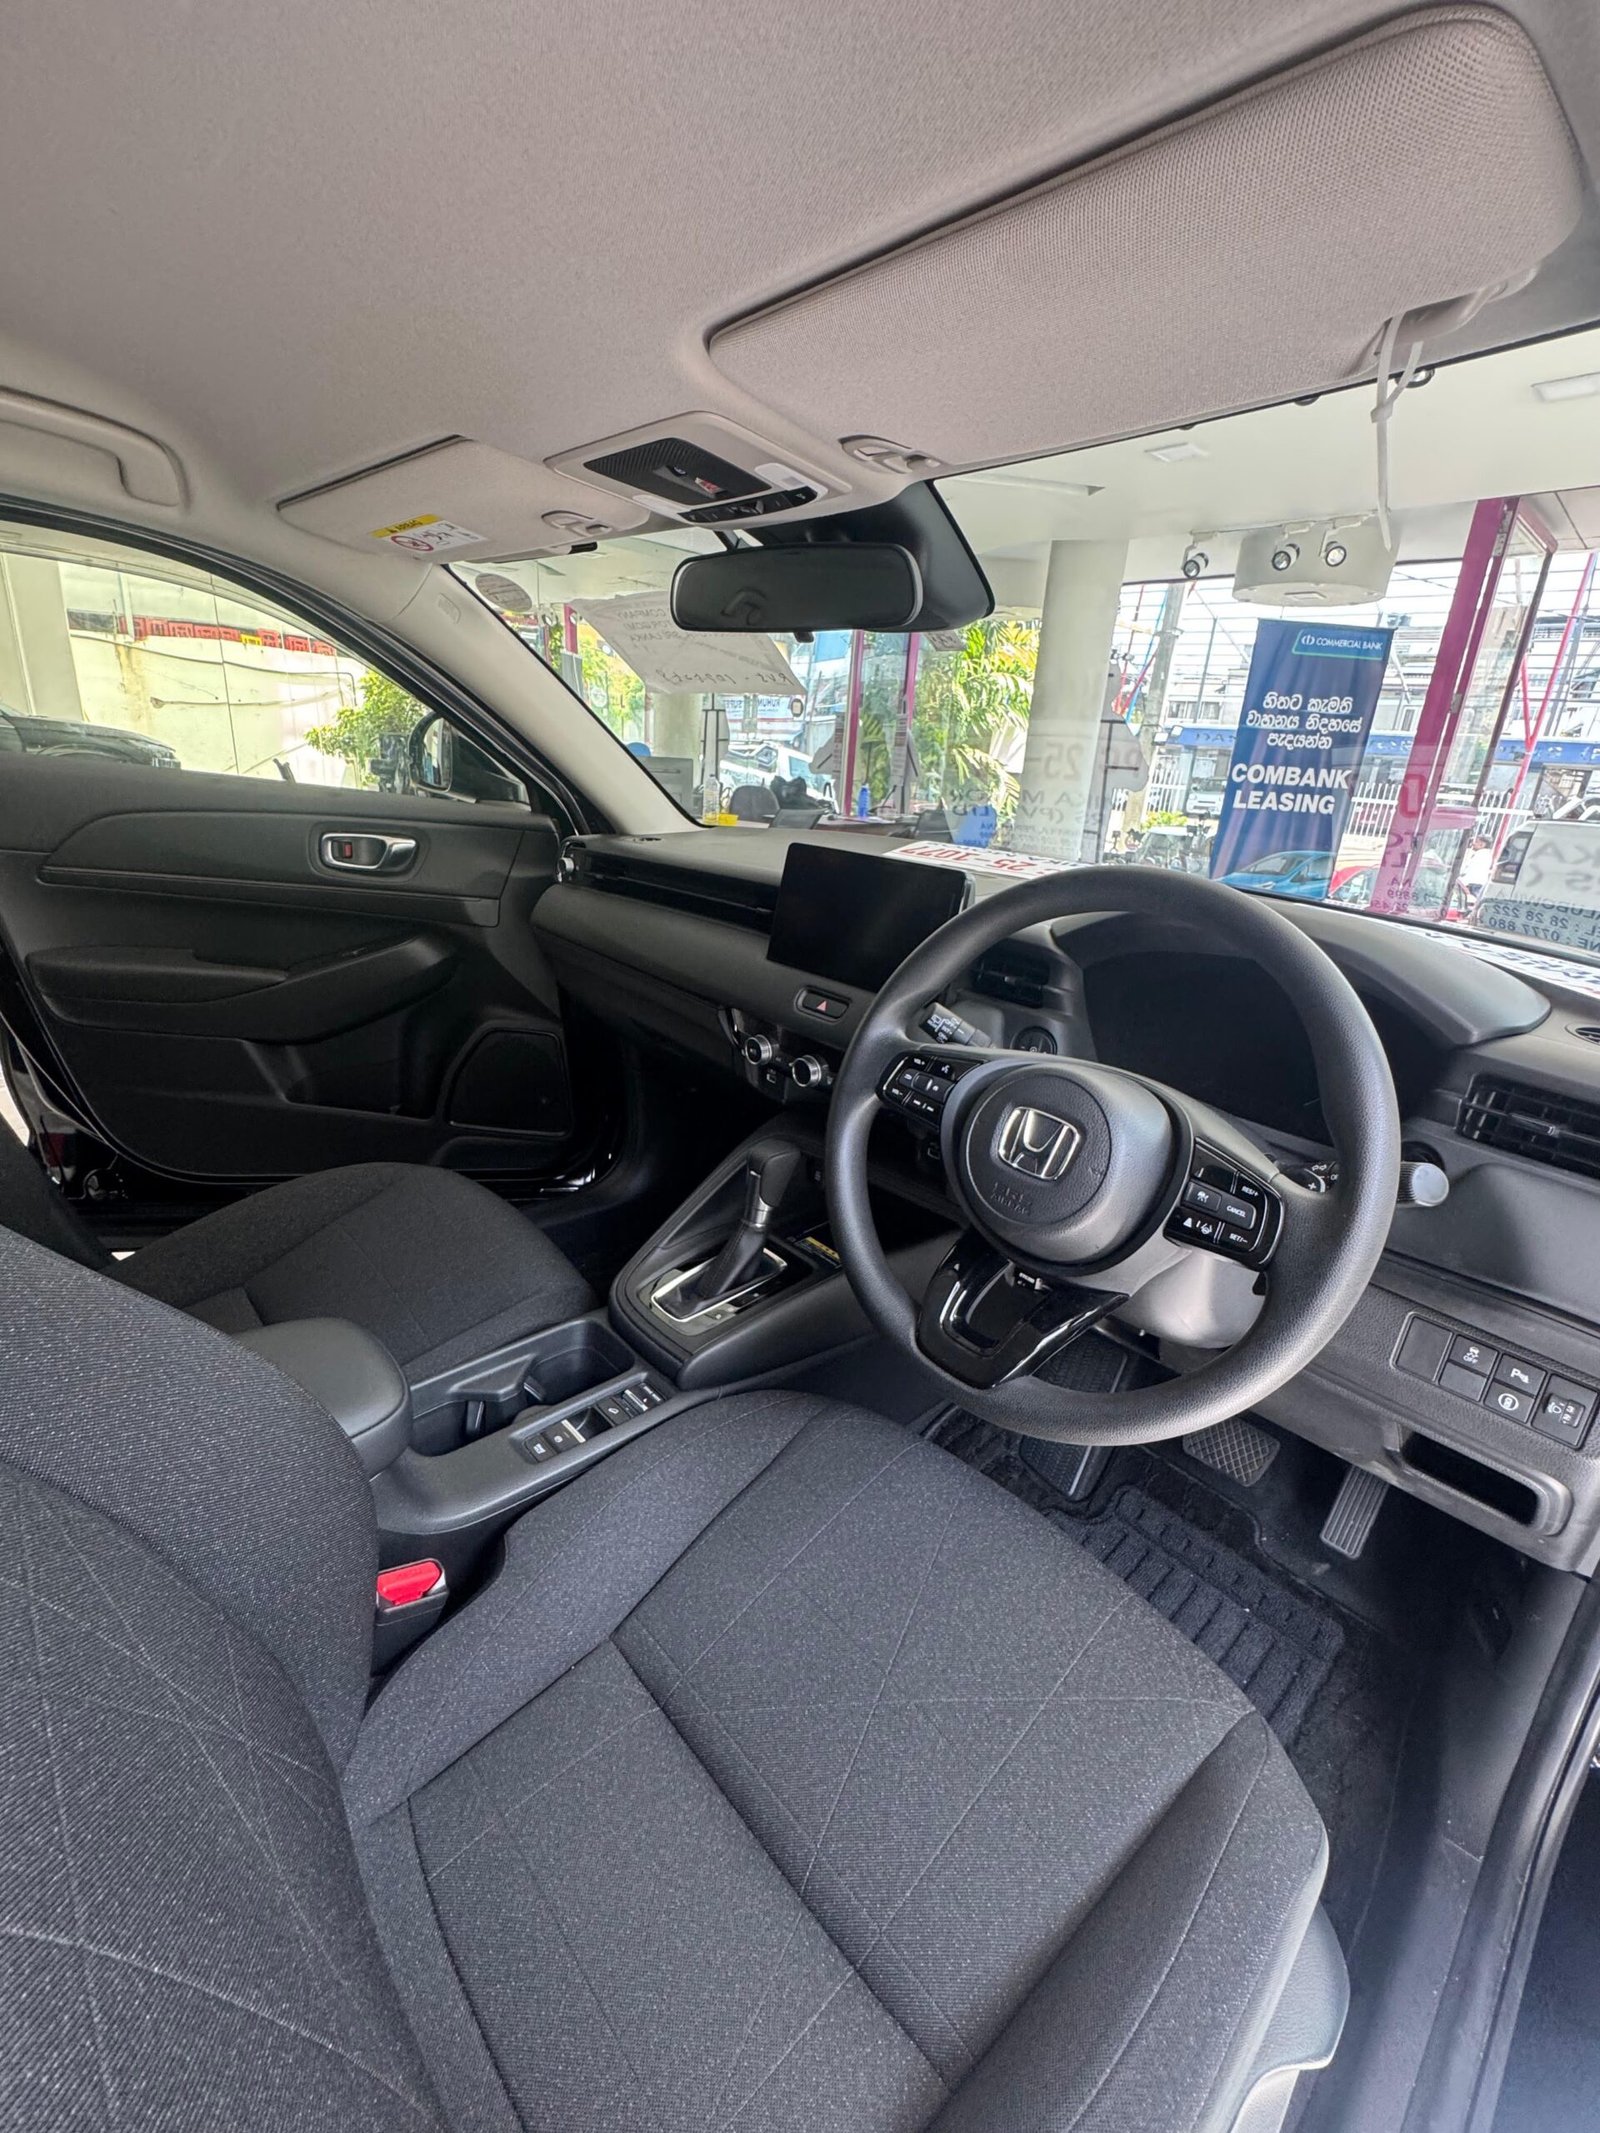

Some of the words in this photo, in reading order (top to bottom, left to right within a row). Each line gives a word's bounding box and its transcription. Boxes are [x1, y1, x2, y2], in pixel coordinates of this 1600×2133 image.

[1315, 637, 1361, 649] COMMERCIAL
[1362, 641, 1384, 650] BANK
[1263, 691, 1303, 710] හිතට
[1307, 696, 1353, 714] කැමති
[1246, 710, 1300, 729] වාහනය
[1305, 713, 1363, 734] නිදහසේ
[1267, 732, 1332, 751] පැදයන්න
[1231, 763, 1352, 789] COMBANK
[1232, 790, 1336, 814] LEASING
[1226, 1205, 1247, 1218] CANCEL
